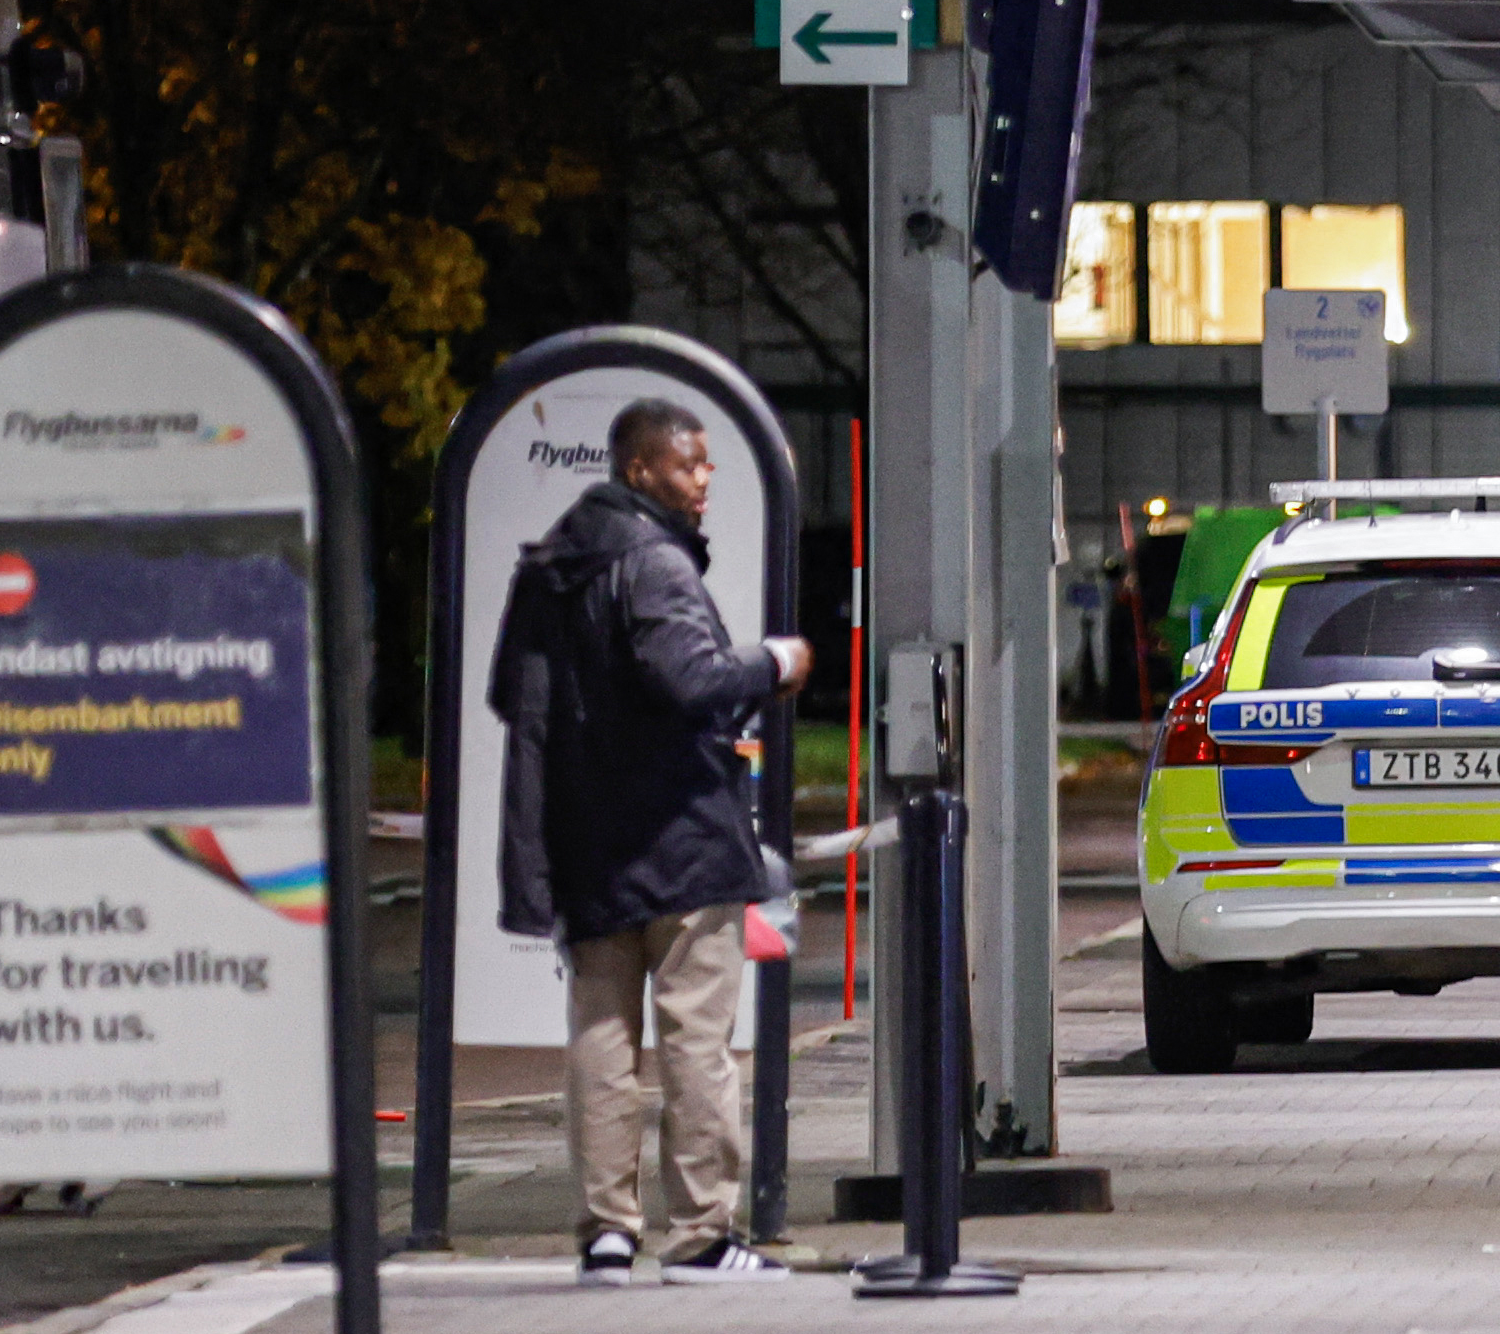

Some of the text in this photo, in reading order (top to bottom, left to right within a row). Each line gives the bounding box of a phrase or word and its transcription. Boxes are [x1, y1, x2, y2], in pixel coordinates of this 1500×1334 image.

[1316, 295, 1329, 319] 2
[97, 634, 275, 681] avstigning
[1240, 702, 1323, 729] POLIS
[1382, 752, 1442, 781] ZTB
[60, 948, 269, 994] travelling
[92, 1014, 156, 1043] us.
